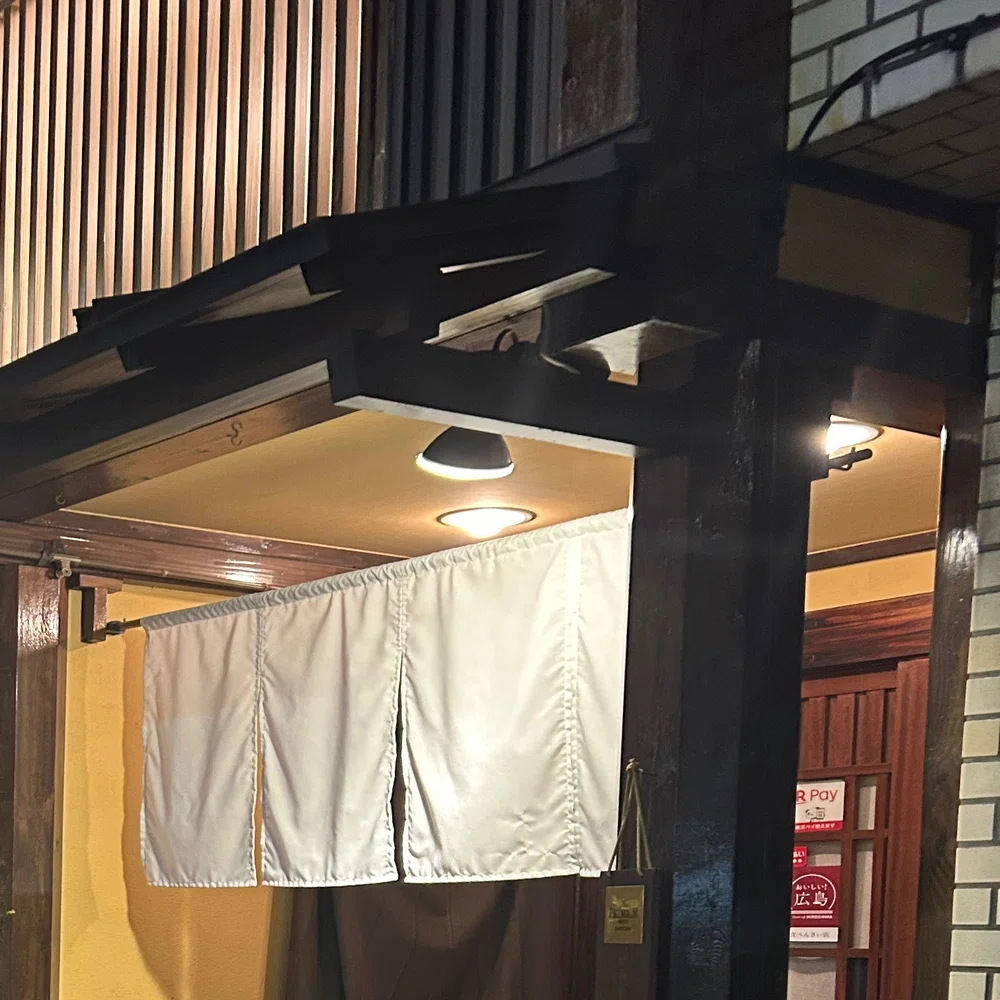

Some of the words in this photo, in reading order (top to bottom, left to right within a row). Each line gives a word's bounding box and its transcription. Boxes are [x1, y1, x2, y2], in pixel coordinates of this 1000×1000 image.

[810, 789, 838, 802] Pay
[795, 883, 828, 891] おいしい!
[794, 891, 828, 907] 広島
